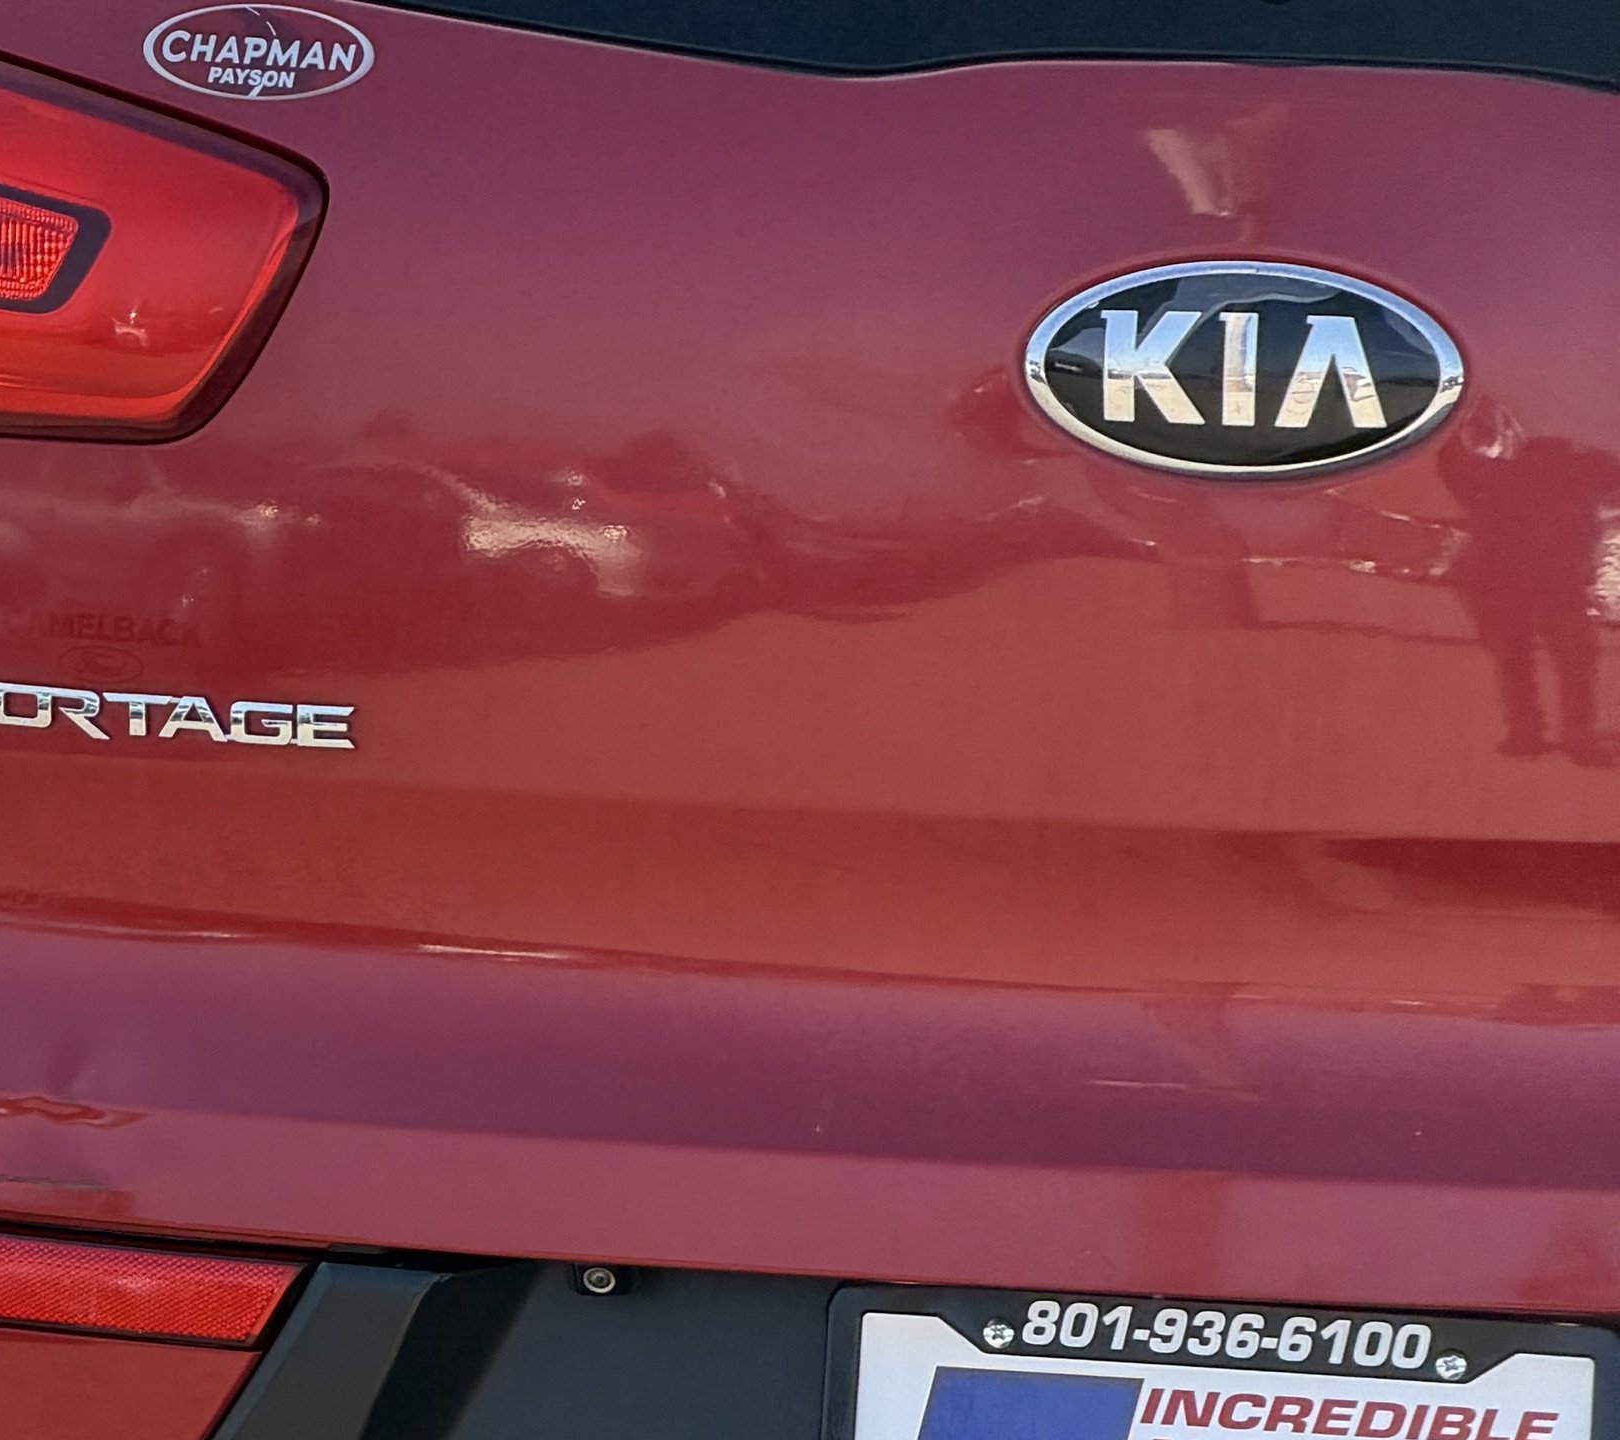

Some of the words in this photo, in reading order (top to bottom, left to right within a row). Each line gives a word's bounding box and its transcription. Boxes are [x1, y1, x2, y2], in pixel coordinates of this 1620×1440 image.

[162, 30, 356, 72] CHAPMAN
[208, 67, 295, 88] PAYSON
[1101, 309, 1387, 428] KIA
[1021, 1300, 1432, 1369] 801-936-6100
